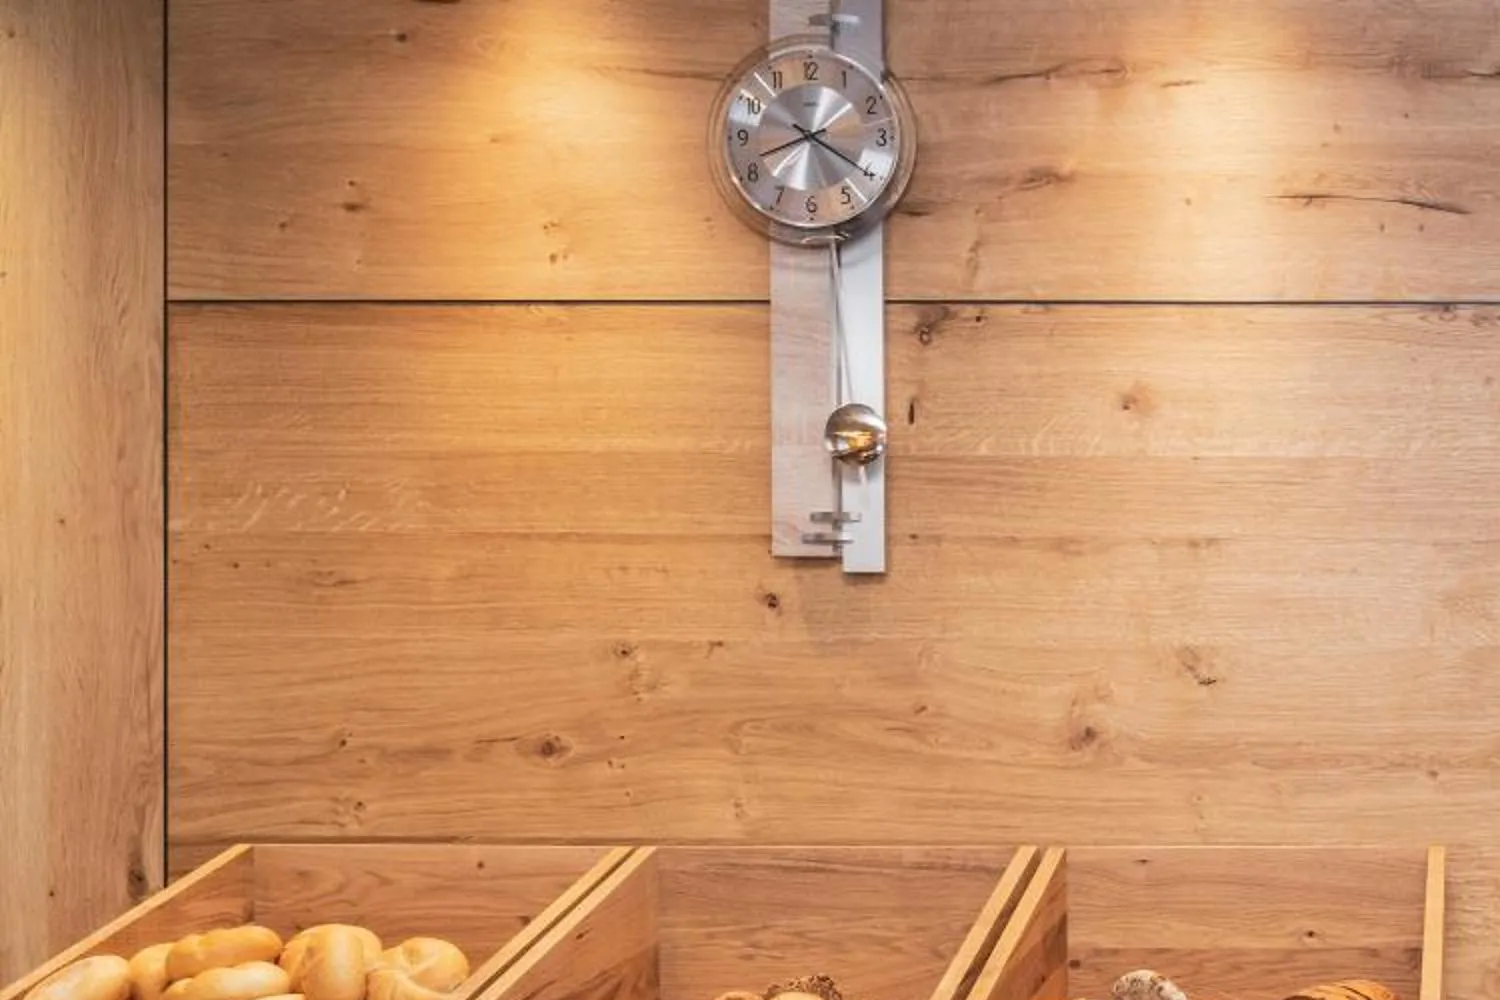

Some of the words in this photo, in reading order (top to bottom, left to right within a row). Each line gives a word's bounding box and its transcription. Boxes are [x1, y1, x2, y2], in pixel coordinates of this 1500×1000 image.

[772, 72, 783, 89] 11
[803, 62, 819, 81] 12
[841, 71, 848, 89] 1
[746, 97, 761, 115] 10
[866, 96, 877, 115] 2
[737, 129, 749, 146] 9
[876, 129, 887, 147] 3
[748, 164, 759, 182] 8
[775, 187, 785, 205] 7
[806, 196, 817, 213] 6
[841, 188, 851, 205] 5
